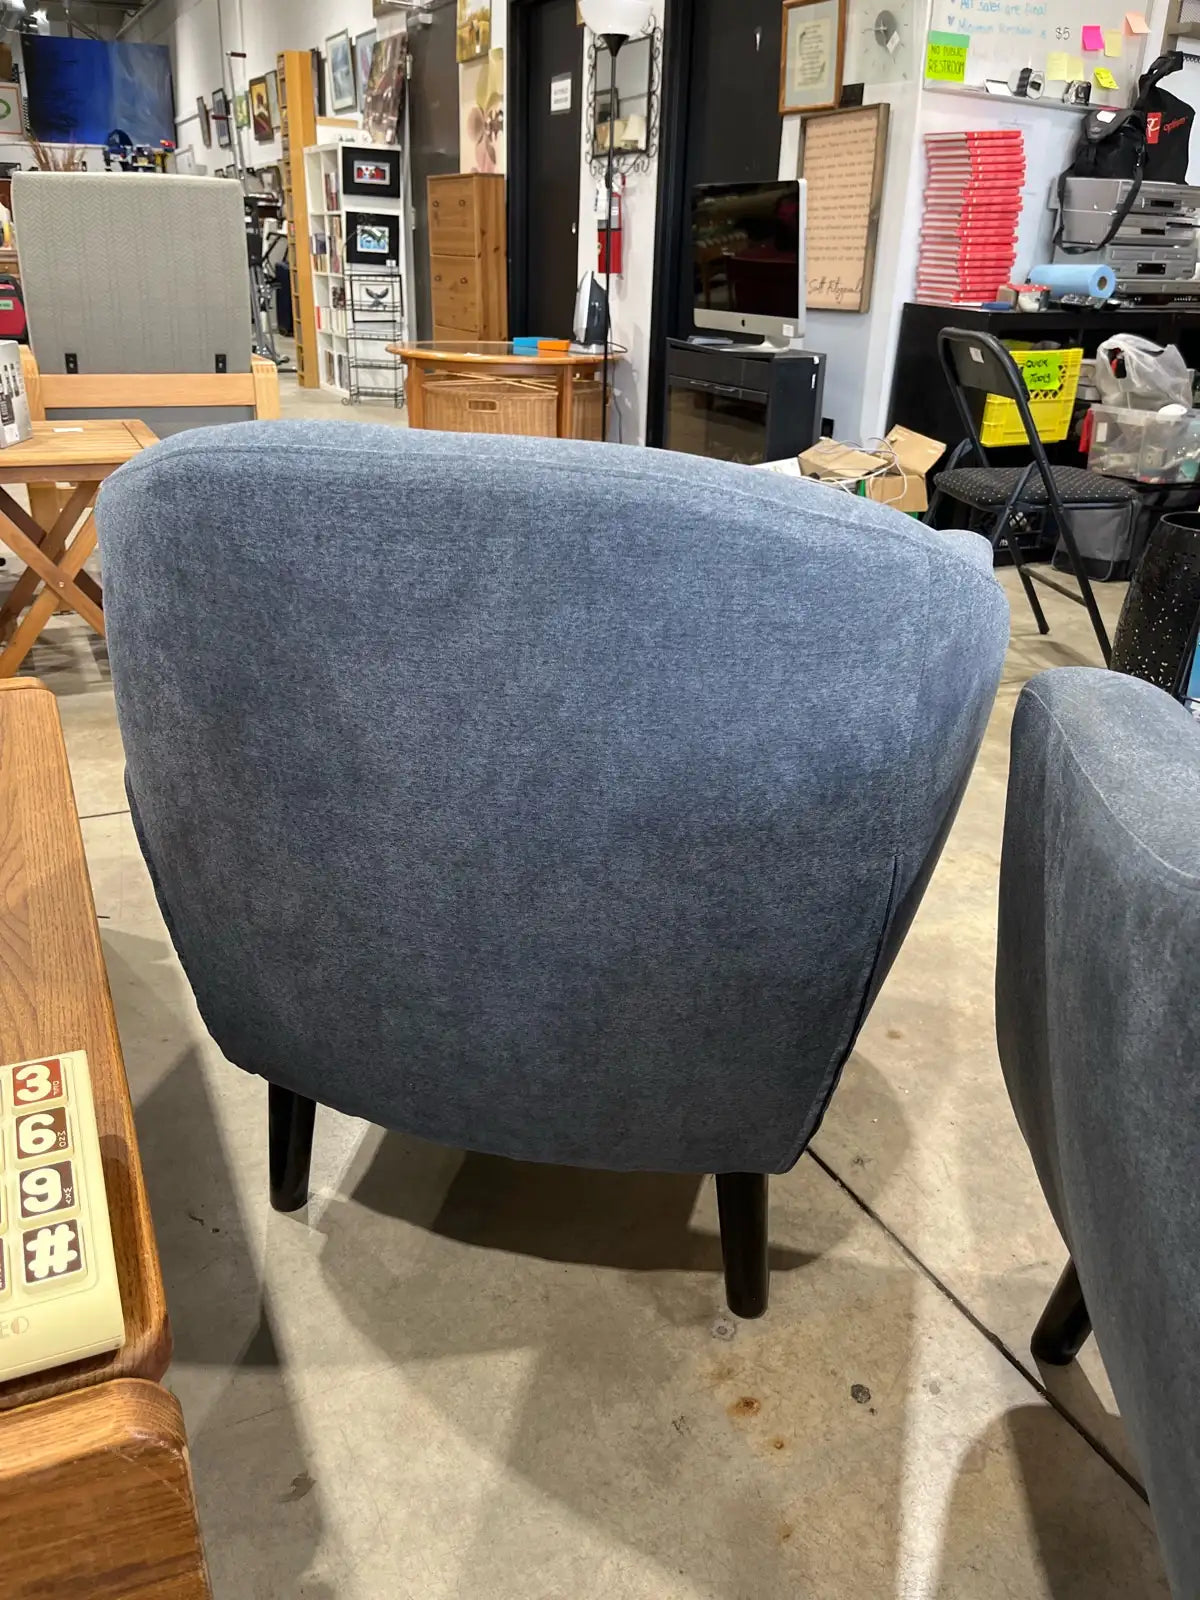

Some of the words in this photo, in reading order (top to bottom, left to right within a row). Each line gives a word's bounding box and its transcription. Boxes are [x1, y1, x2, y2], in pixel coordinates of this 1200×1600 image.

[1055, 26, 1071, 41] $5
[931, 45, 940, 55] NO
[928, 58, 965, 75] RESTROOM
[15, 1064, 52, 1102] 3
[19, 1113, 57, 1155] 6
[57, 1130, 66, 1148] MNO
[22, 1167, 63, 1213] 9
[63, 1186, 73, 1205] WXY
[26, 1223, 78, 1279] #
